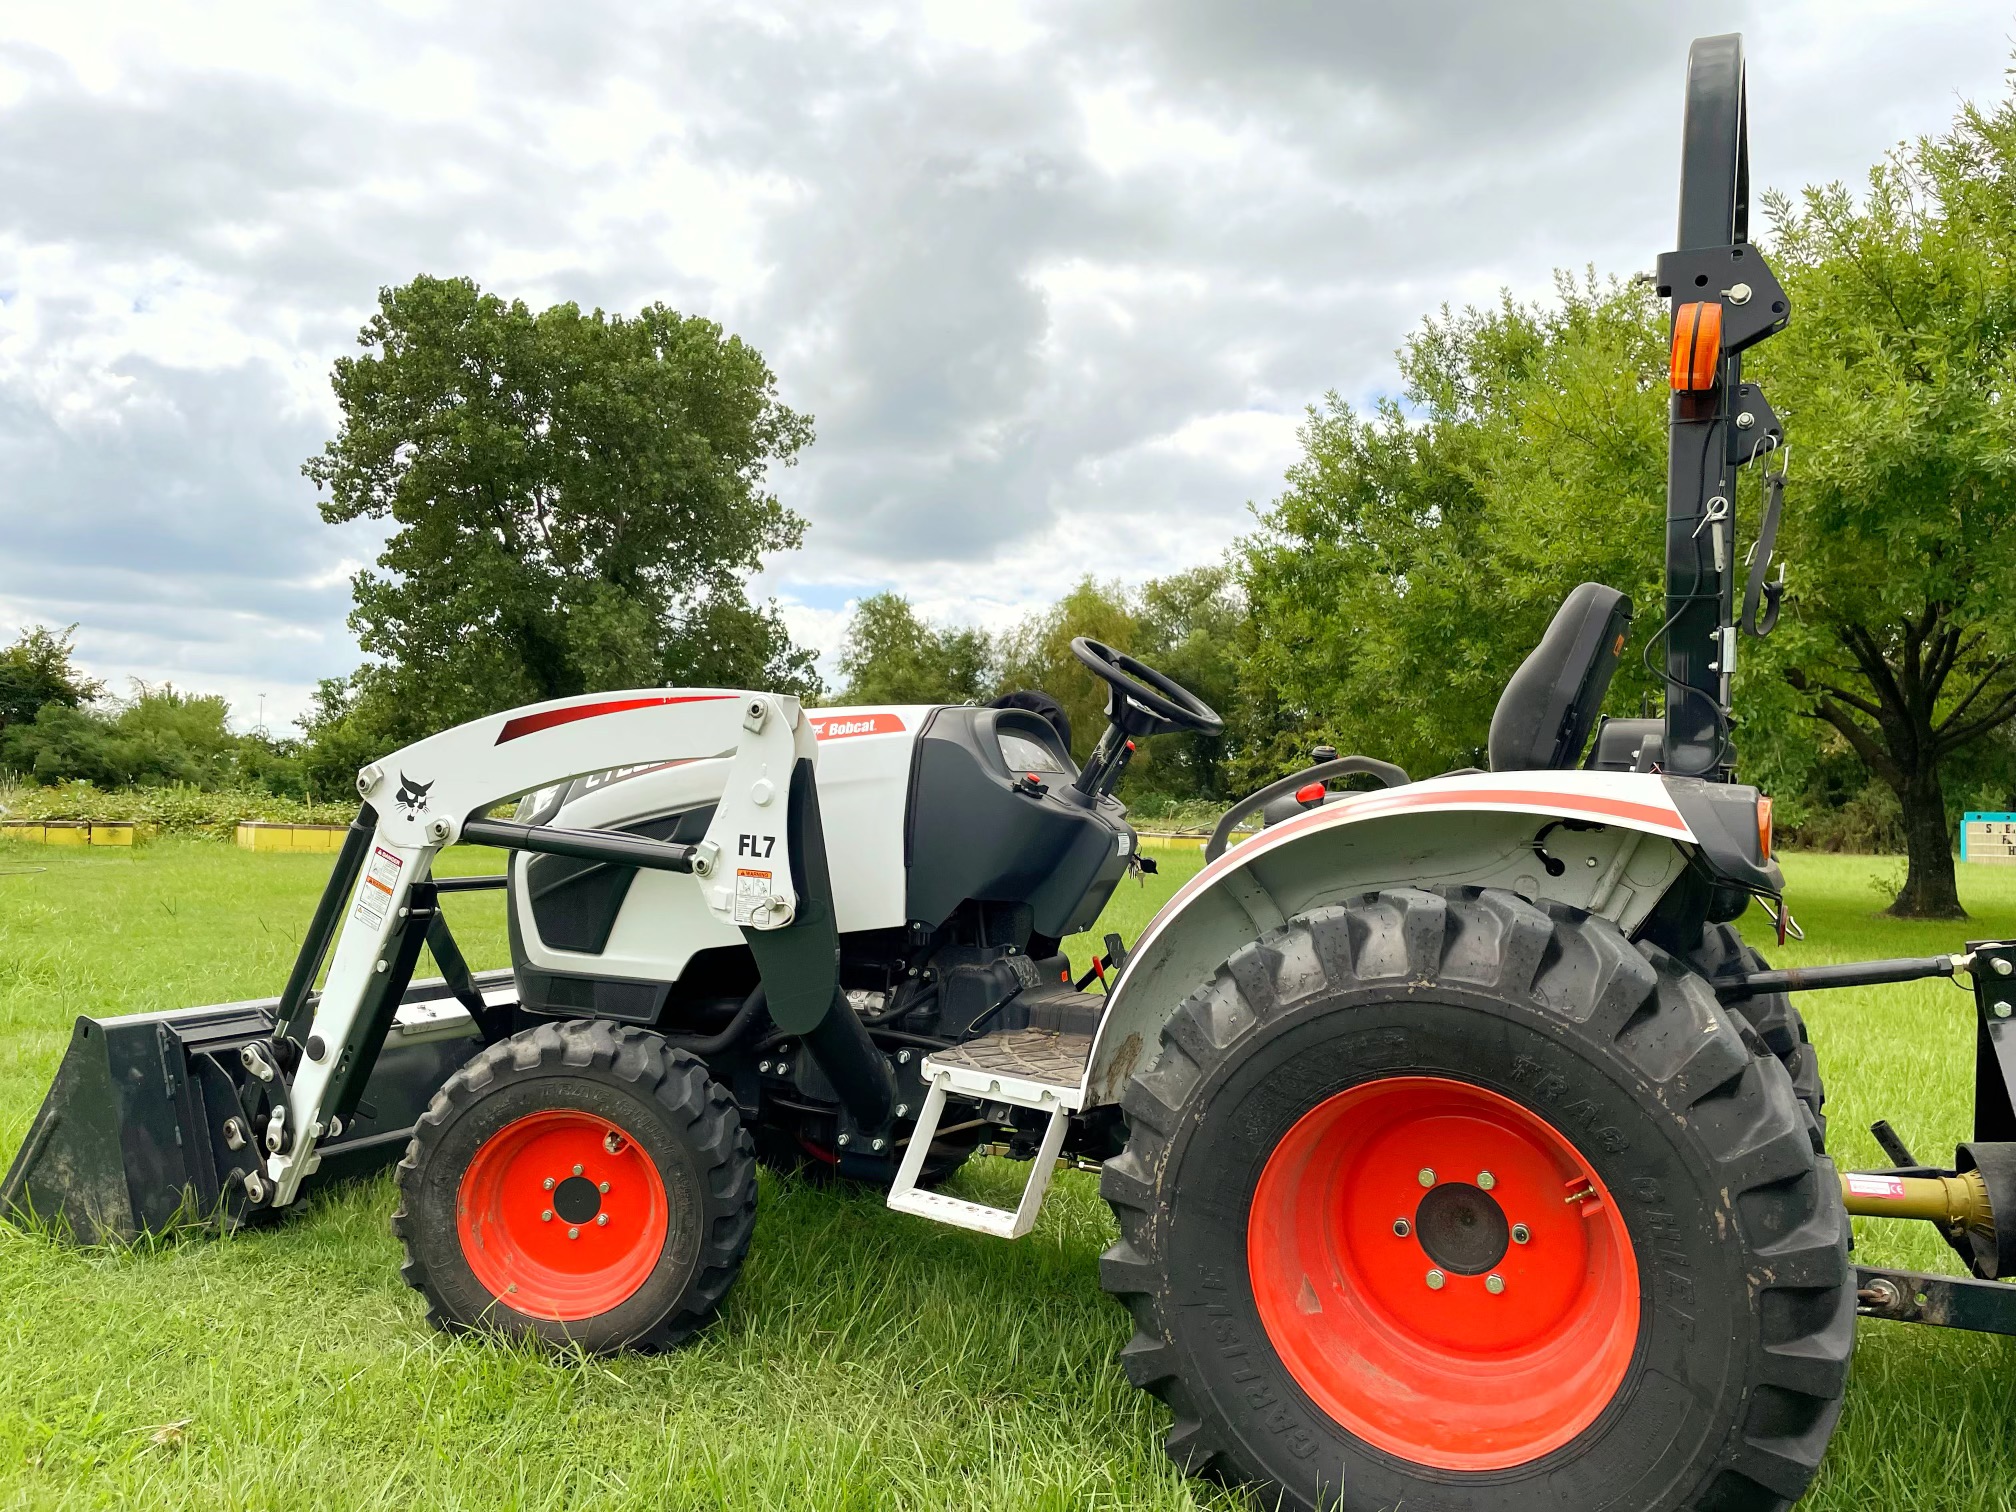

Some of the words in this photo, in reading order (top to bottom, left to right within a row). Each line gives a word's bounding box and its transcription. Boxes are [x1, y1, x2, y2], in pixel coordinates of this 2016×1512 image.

[829, 719, 875, 736] Bobcat
[739, 834, 776, 858] FL7
[382, 851, 400, 865] DANGER
[539, 1082, 611, 1105] TRAC
[1511, 1054, 1630, 1152] TRAC
